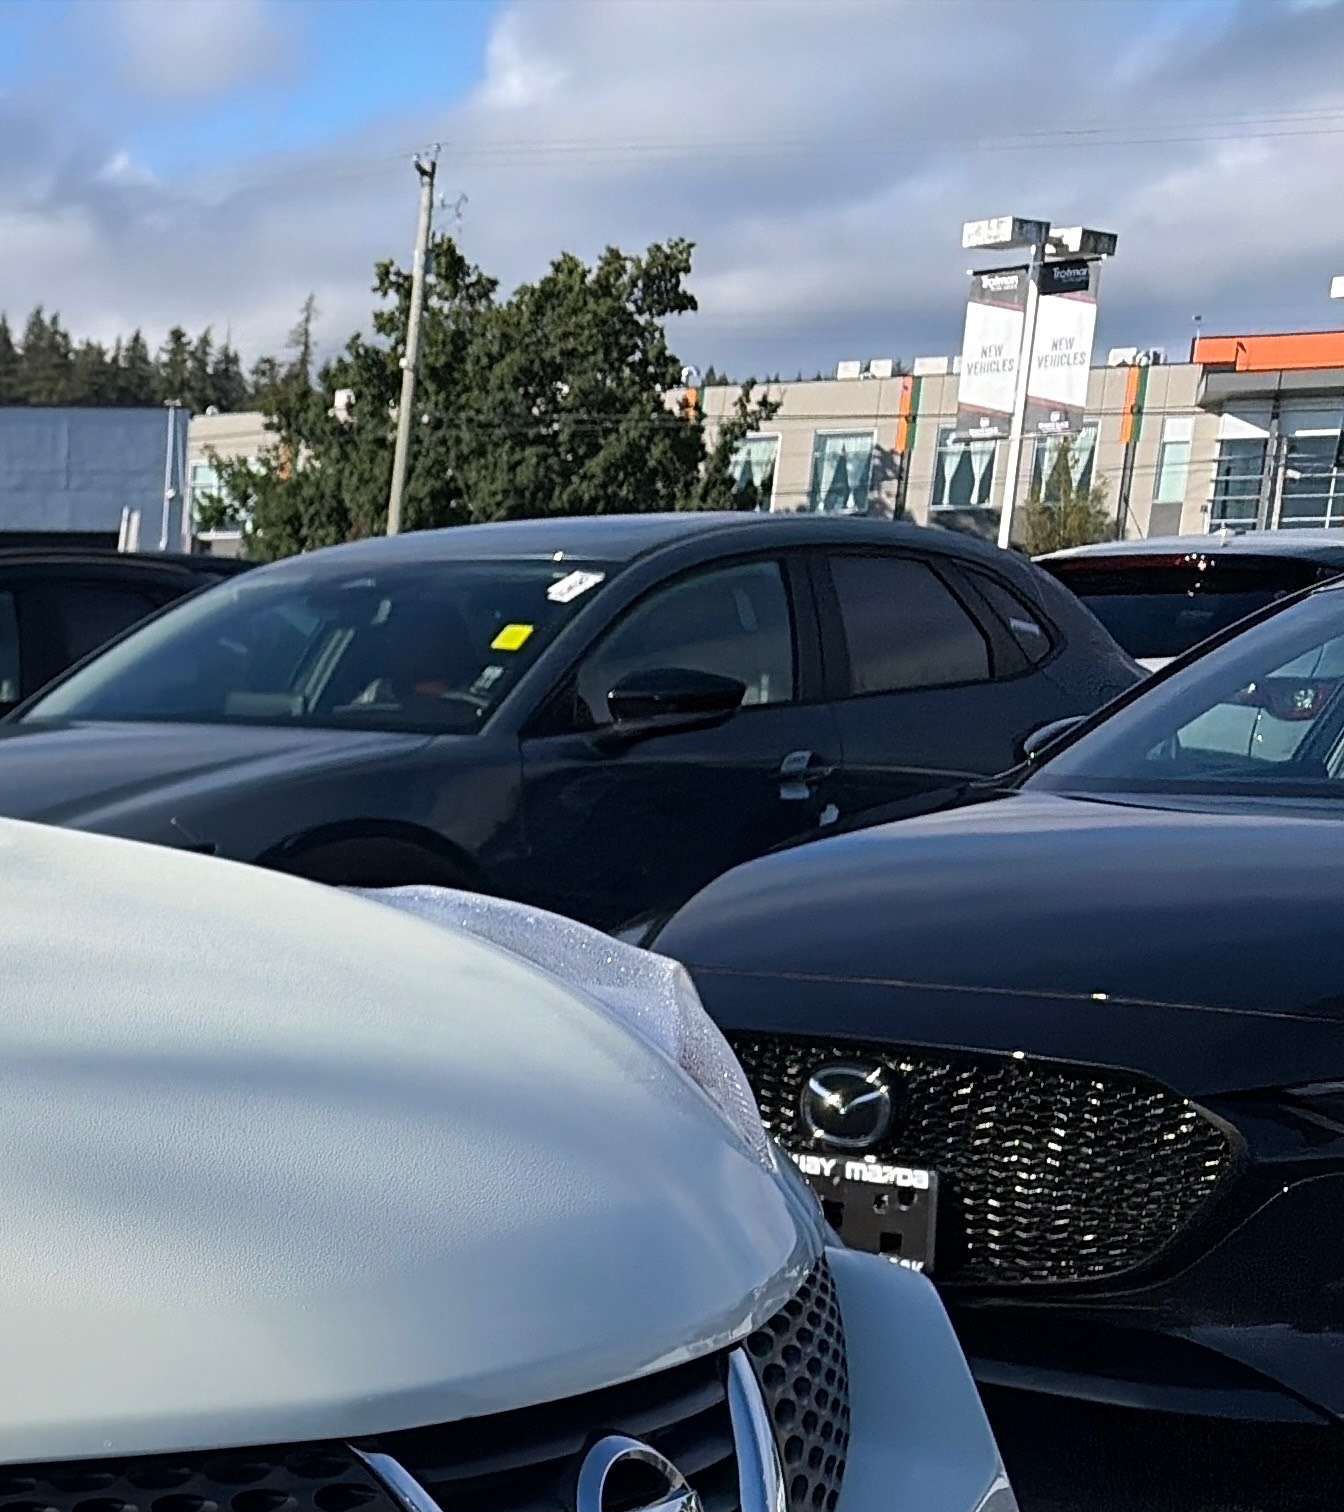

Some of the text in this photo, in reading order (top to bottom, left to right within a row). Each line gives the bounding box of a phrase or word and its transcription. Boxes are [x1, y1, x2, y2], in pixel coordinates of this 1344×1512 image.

[981, 344, 1004, 359] NEW
[1052, 336, 1075, 351] NEW
[967, 358, 1014, 376] VEHICLES
[1037, 351, 1087, 369] VEHICLES
